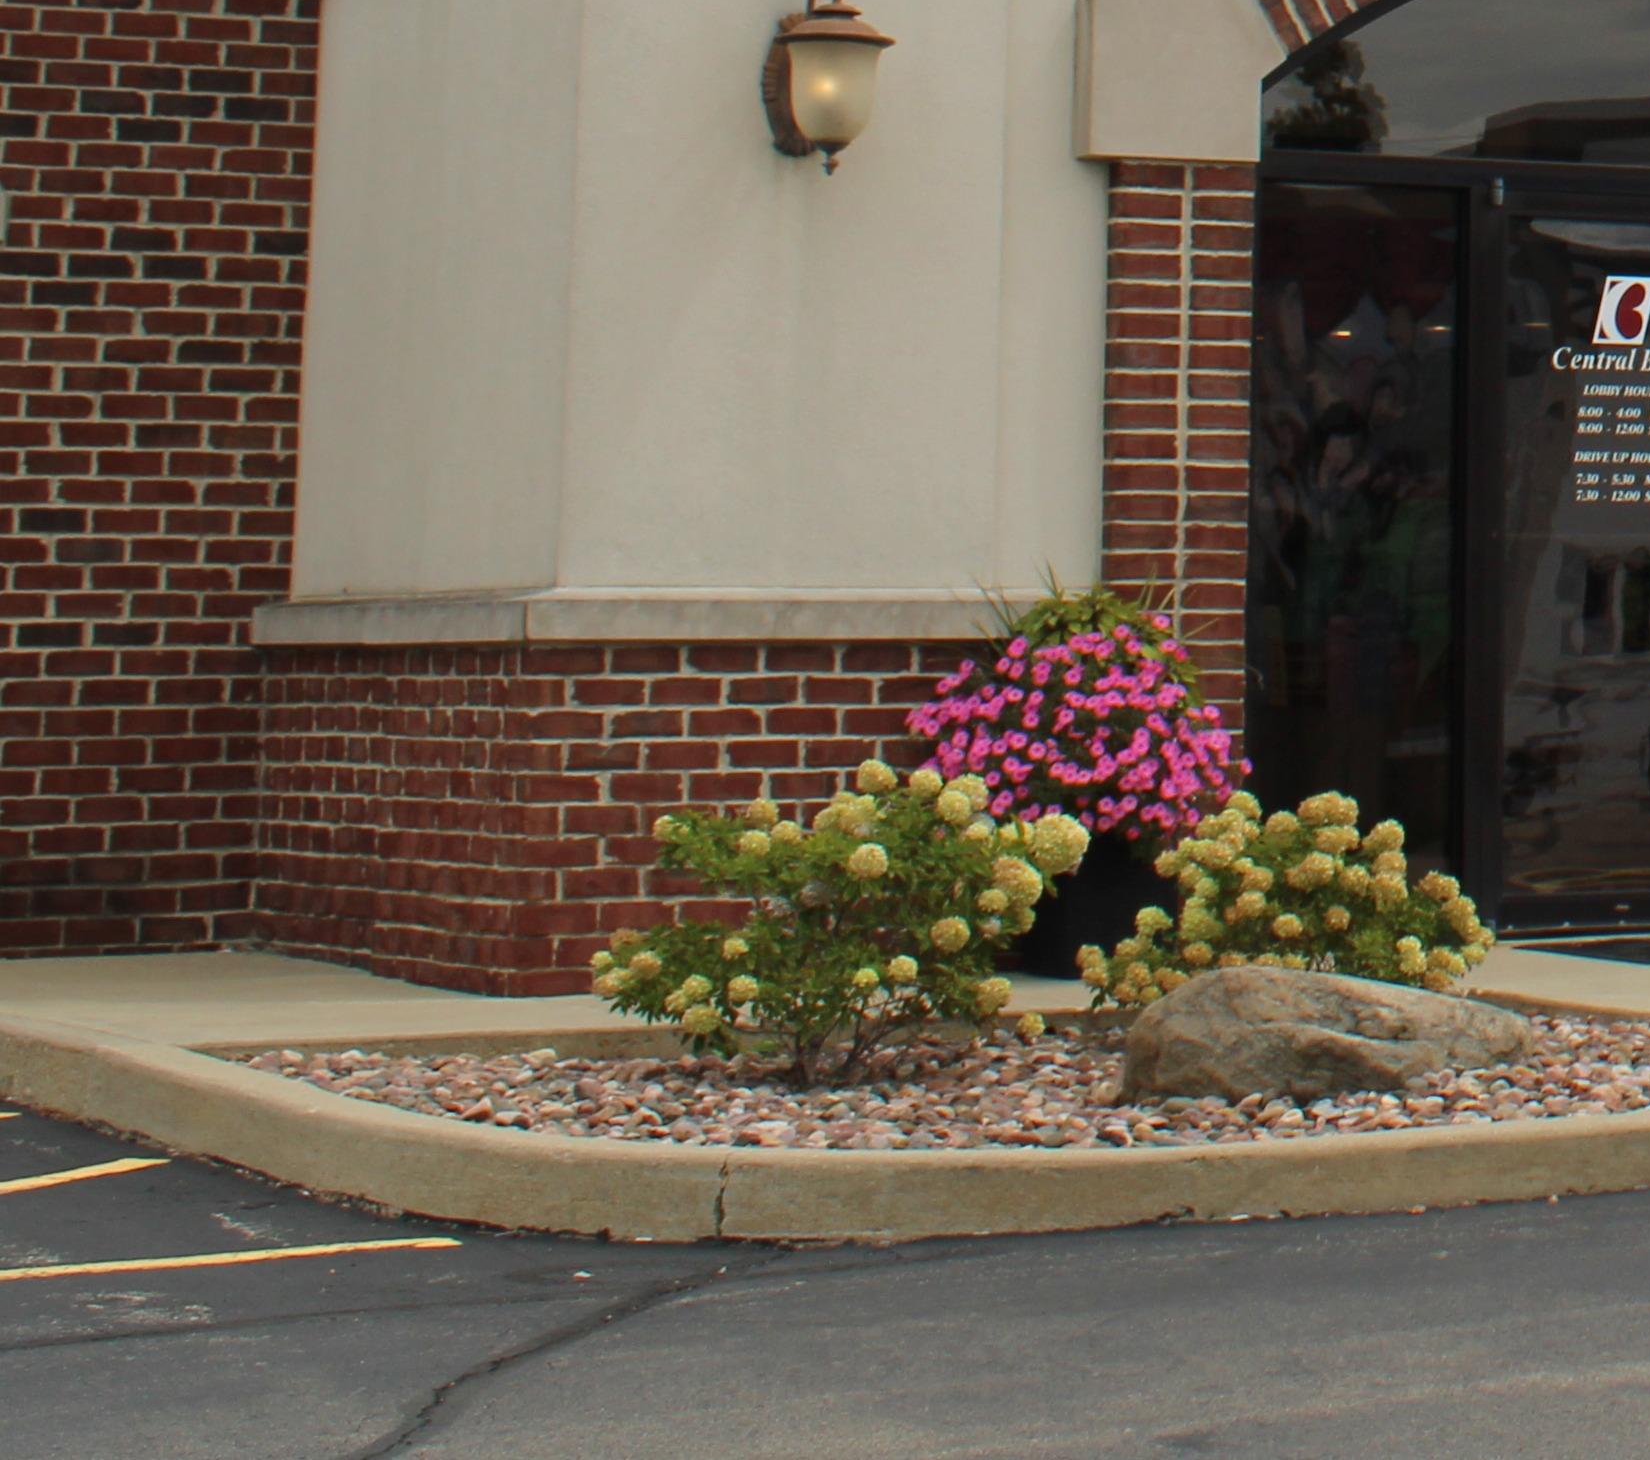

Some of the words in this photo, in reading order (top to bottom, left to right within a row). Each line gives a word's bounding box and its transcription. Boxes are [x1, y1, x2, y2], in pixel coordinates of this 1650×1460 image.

[1552, 346, 1637, 371] Central
[1583, 384, 1622, 397] LOBBY
[1574, 450, 1610, 463] DRIVE
[1612, 451, 1629, 463] UP
